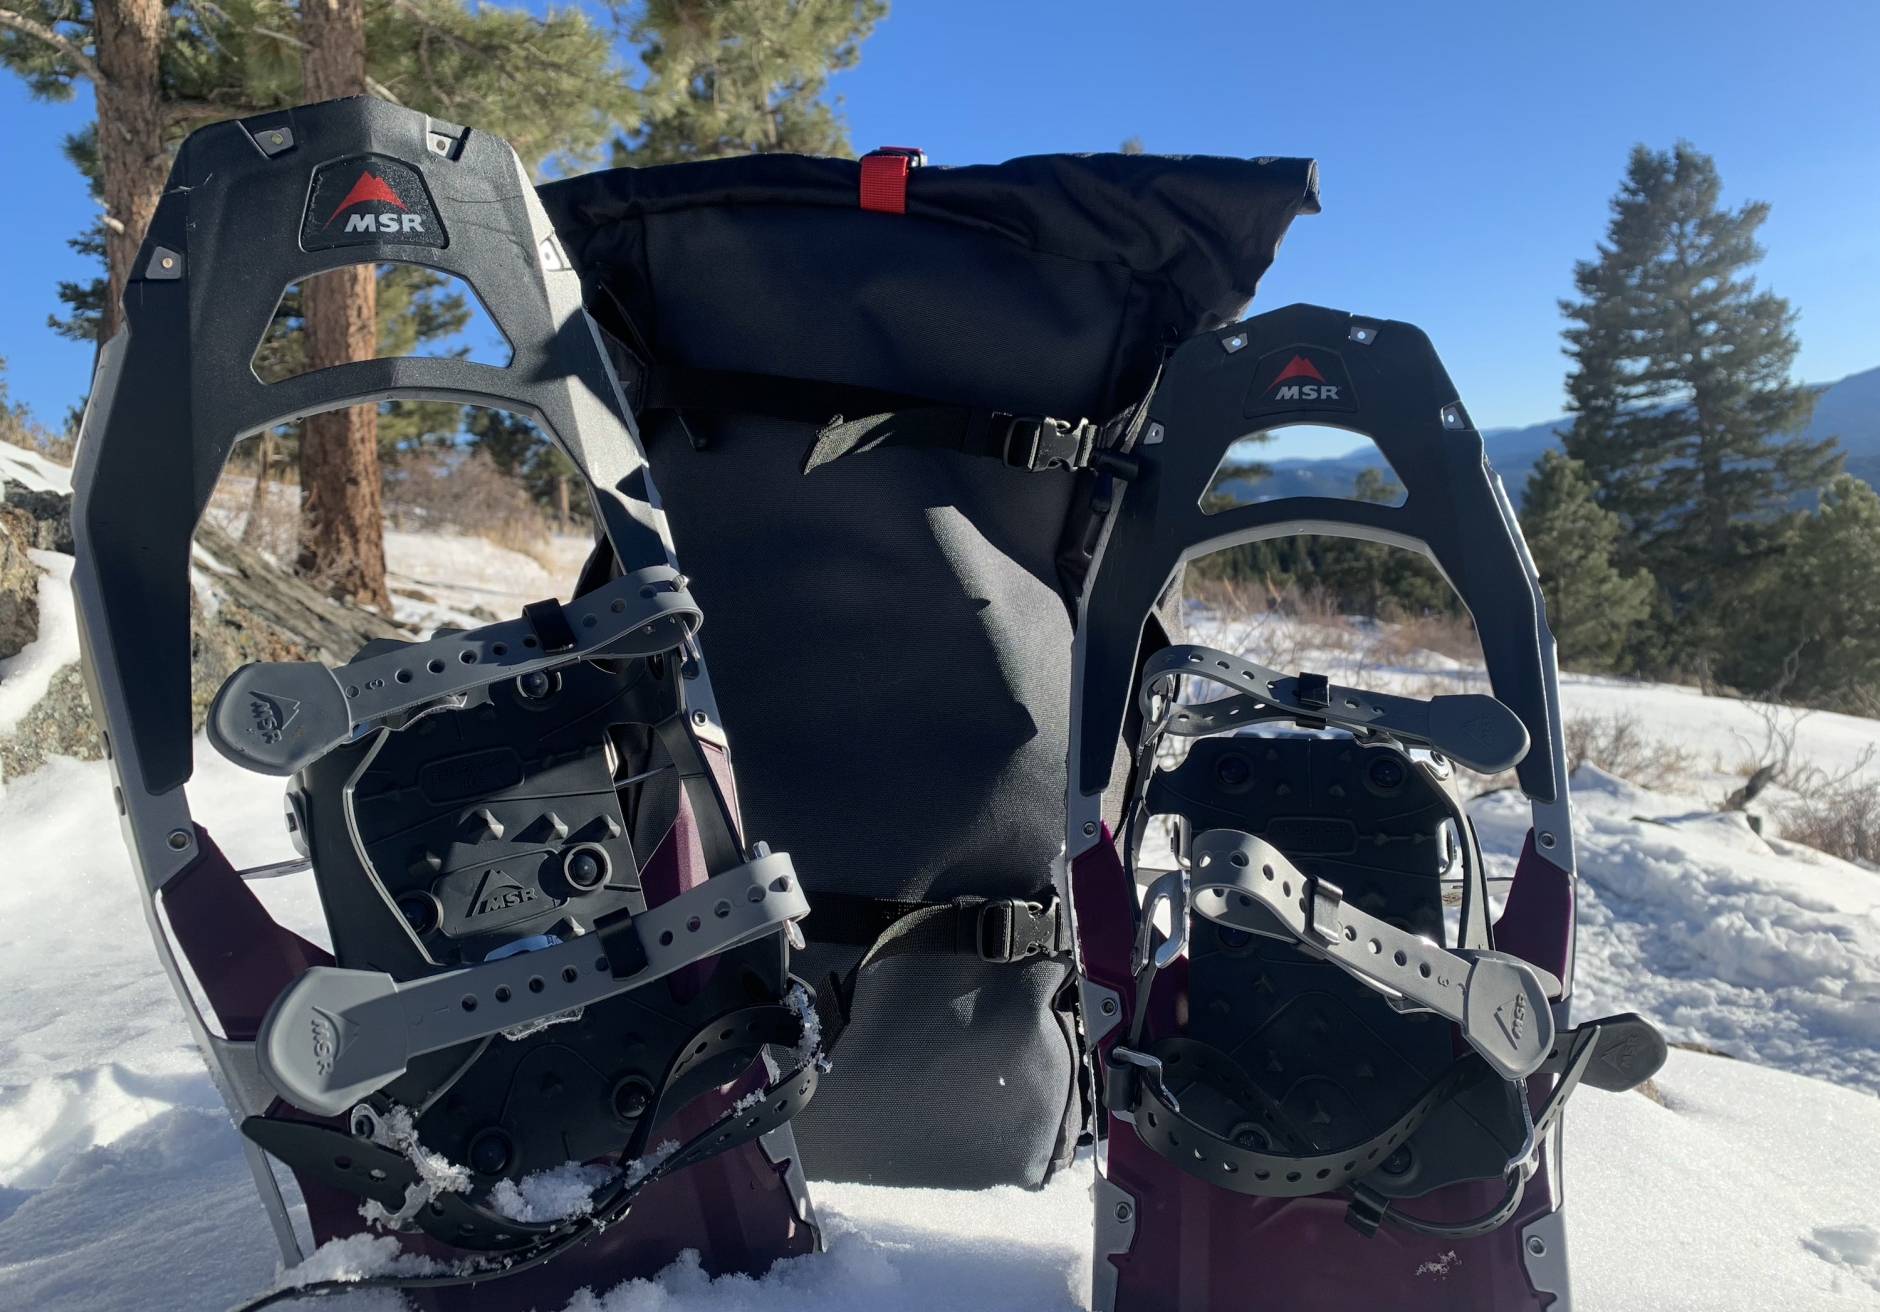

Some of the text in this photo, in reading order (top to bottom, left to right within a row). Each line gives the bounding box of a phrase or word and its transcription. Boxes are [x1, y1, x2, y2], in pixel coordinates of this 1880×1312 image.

[344, 213, 425, 233] MSR
[1274, 385, 1340, 400] MSR
[250, 701, 283, 744] MSR
[485, 887, 538, 913] MSR
[1511, 991, 1529, 1040] MSR
[311, 1018, 334, 1076] MSR
